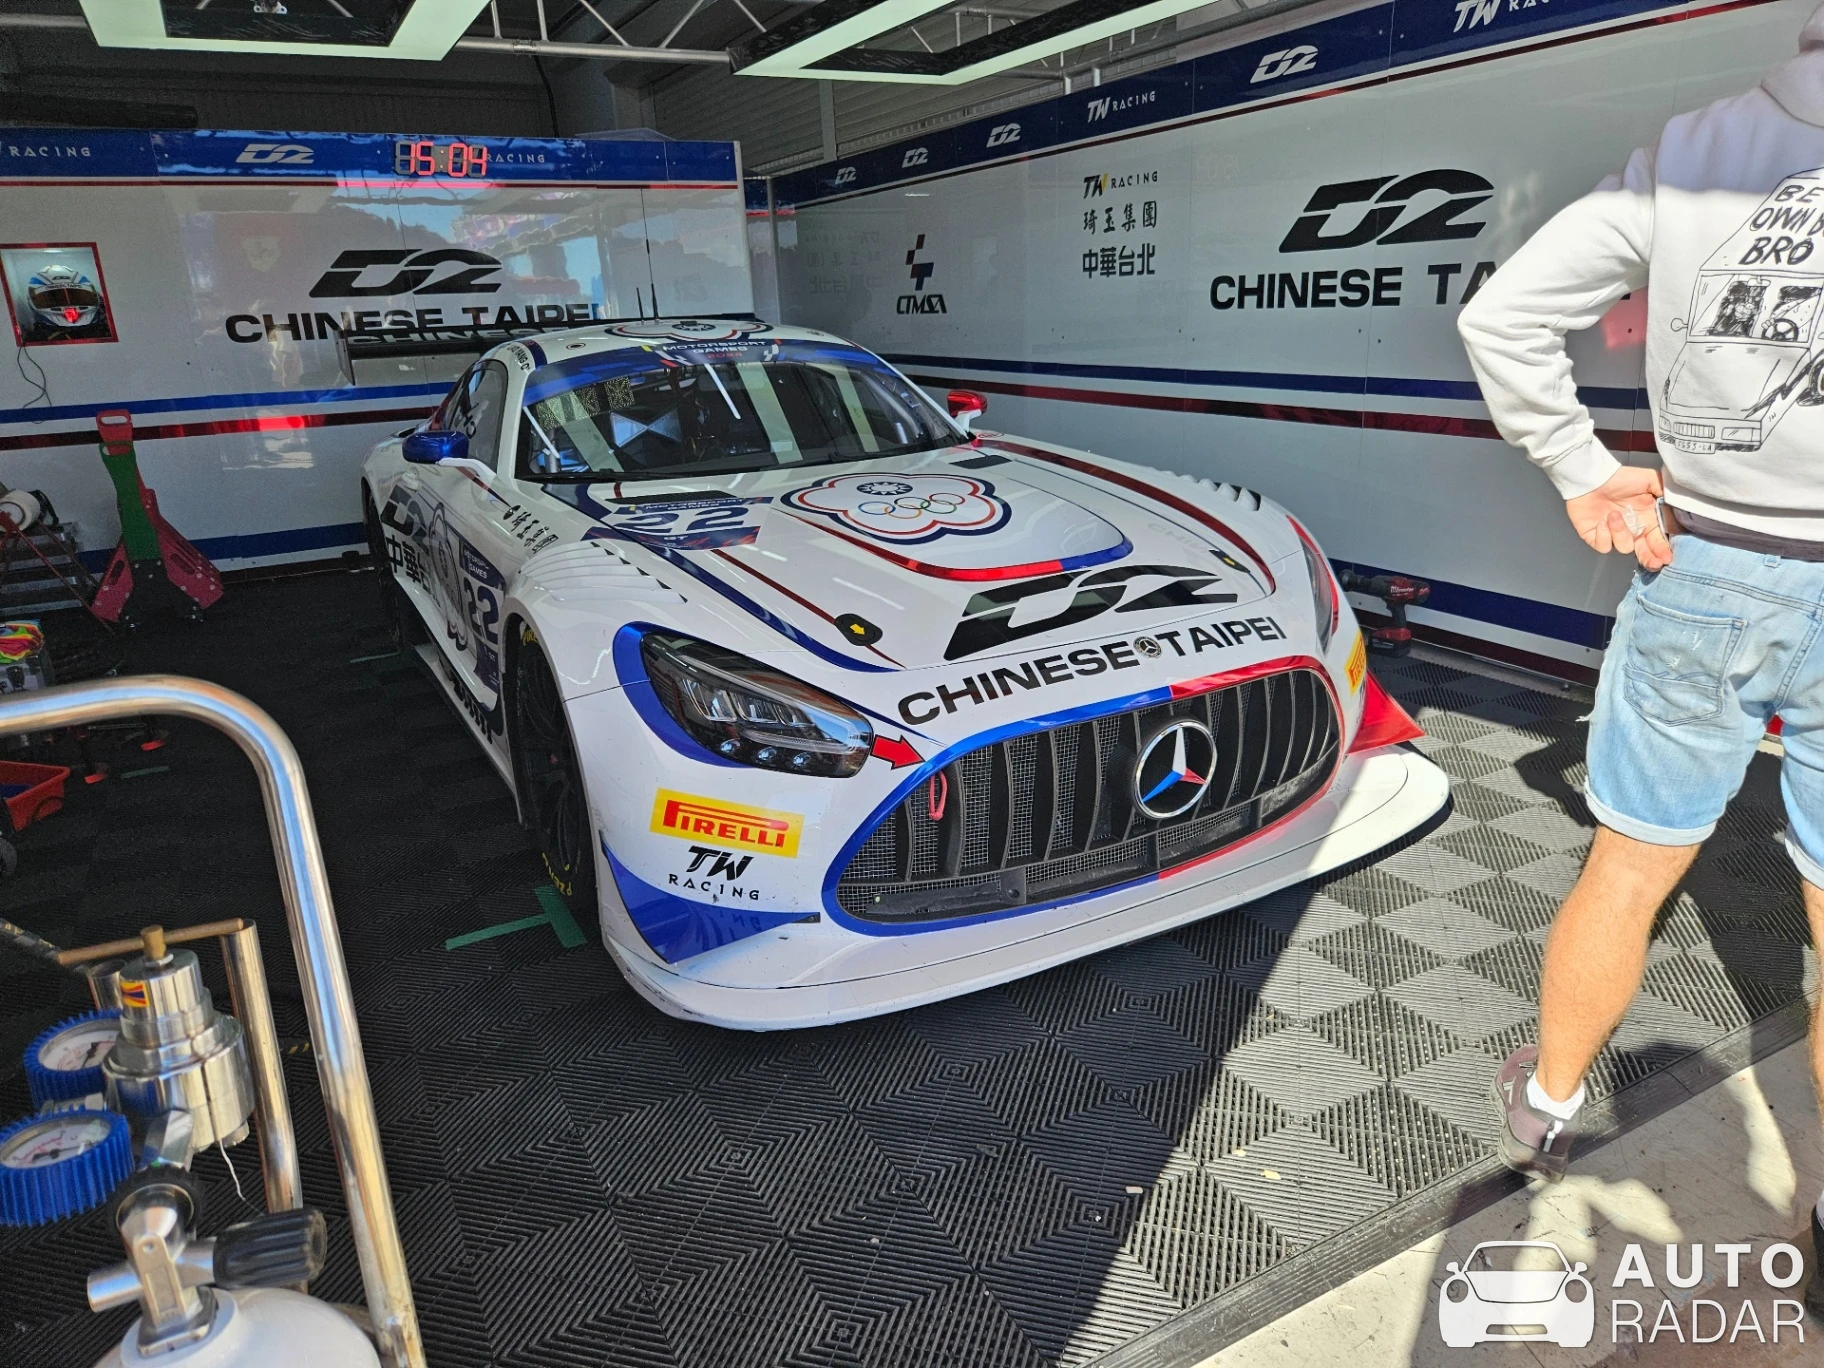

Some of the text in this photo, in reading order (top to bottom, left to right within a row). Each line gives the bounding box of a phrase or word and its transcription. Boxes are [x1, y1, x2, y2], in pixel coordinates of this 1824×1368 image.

[1453, 0, 1500, 33] TW
[1250, 45, 1318, 84] D2
[1087, 91, 1156, 123] TW RACING
[8, 145, 91, 157] RACING
[986, 122, 1021, 148] D2
[235, 143, 315, 164] D2
[409, 141, 487, 178] 15:04
[902, 147, 929, 168] D2
[1083, 171, 1158, 199] TW RACING
[1278, 168, 1494, 254] D2
[1750, 206, 1817, 234] OWN
[1082, 243, 1156, 279] 中華台北
[1738, 236, 1814, 265] BRO
[309, 248, 502, 298] D2
[1209, 266, 1401, 310] CHINESE
[225, 308, 444, 344] CHINESE
[662, 341, 767, 351] MOTORSPORT
[693, 346, 748, 354] GAMES
[613, 506, 749, 533] 22
[464, 577, 499, 645] 22
[944, 564, 1238, 661] D2
[897, 616, 1287, 727] CHINESE TAIPEI
[663, 800, 789, 848] PIRELLI
[685, 845, 754, 881] TW
[668, 873, 759, 900] RACING
